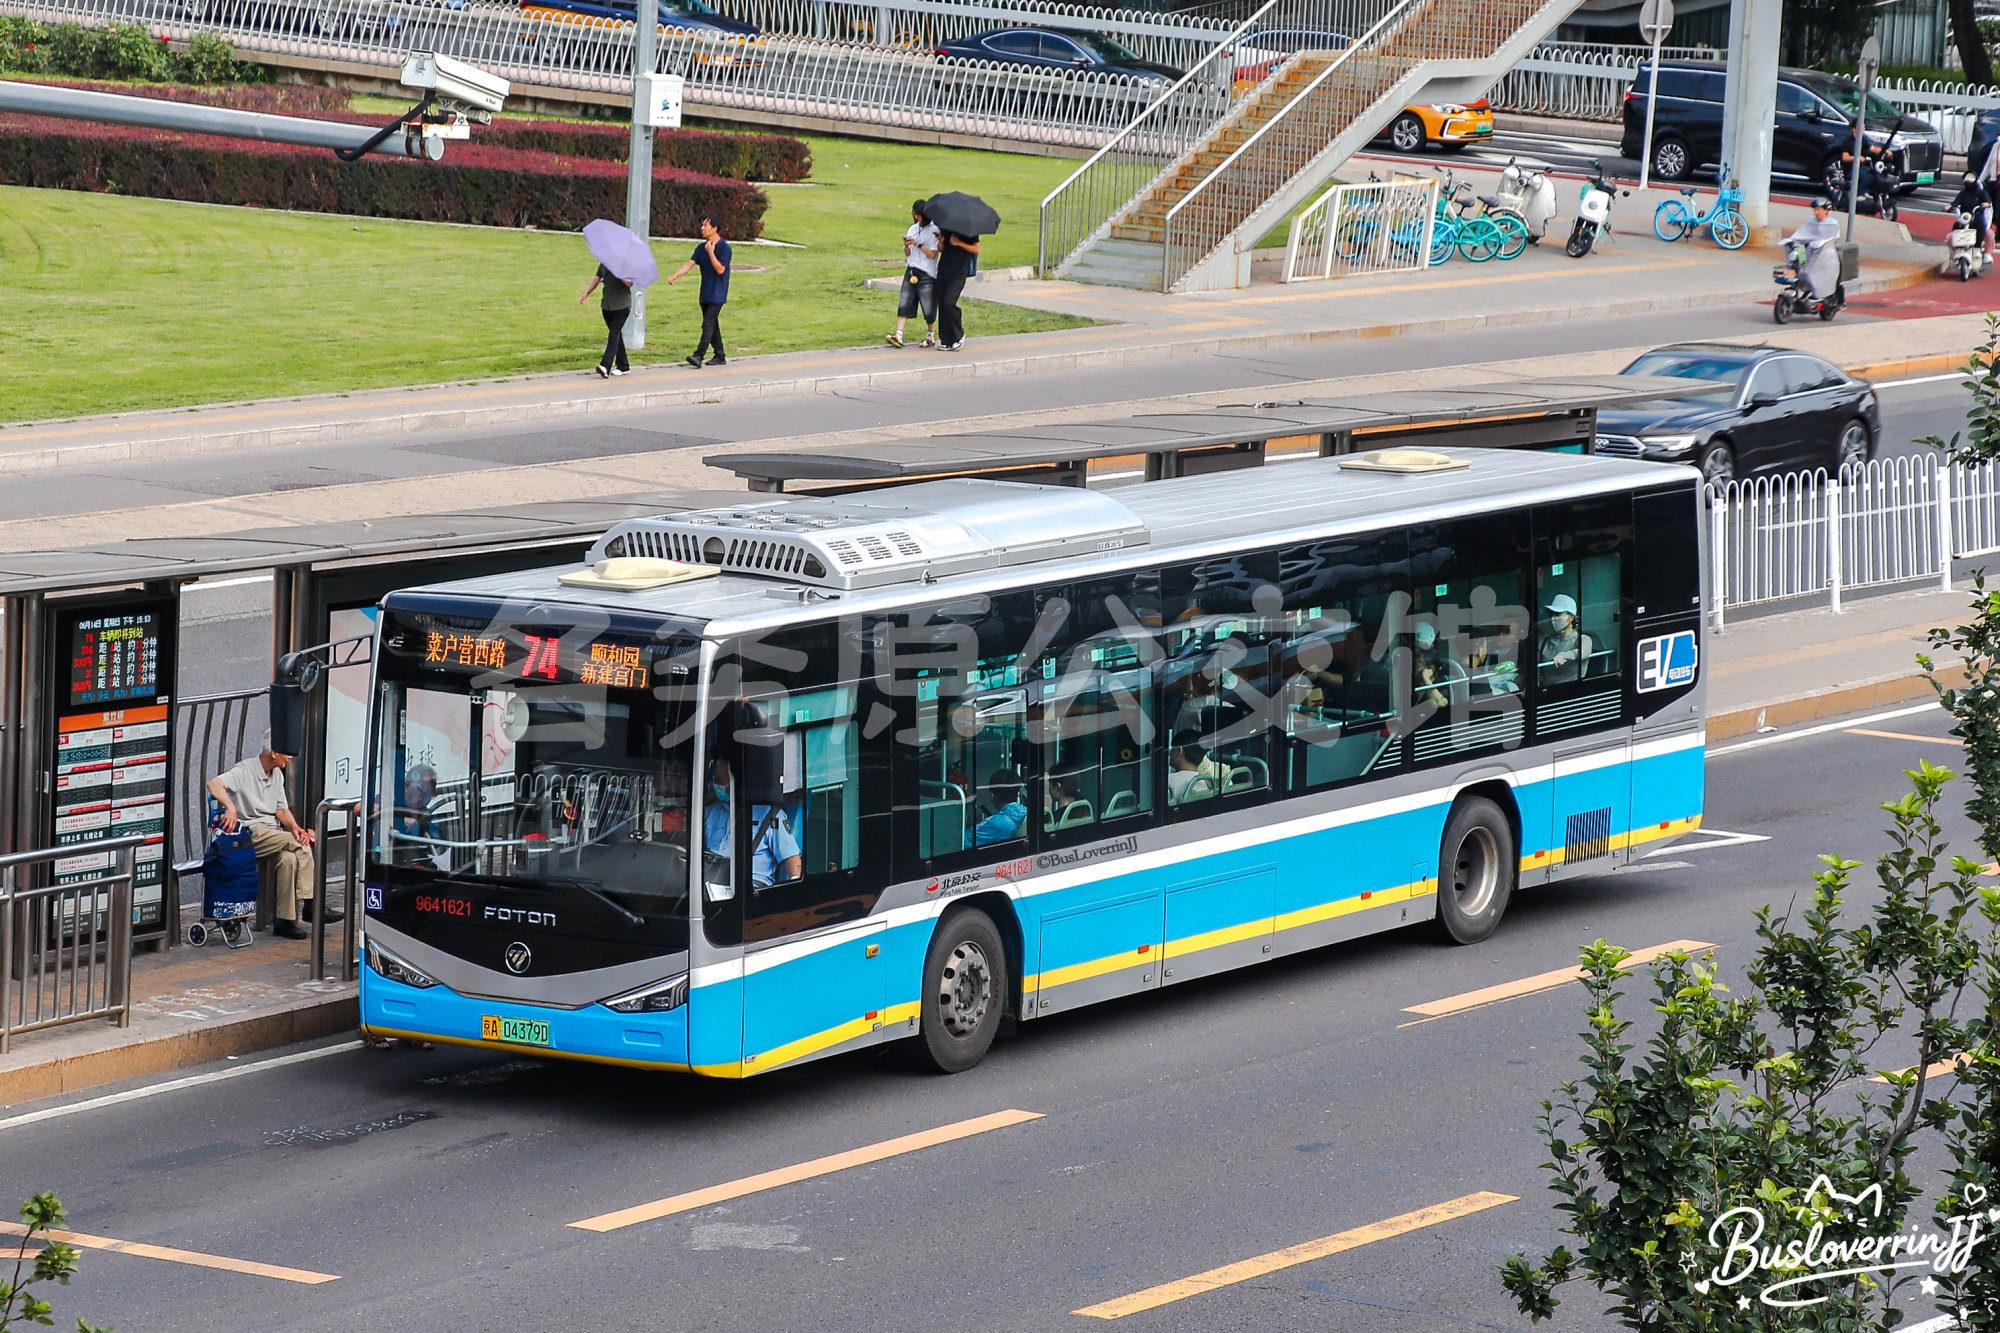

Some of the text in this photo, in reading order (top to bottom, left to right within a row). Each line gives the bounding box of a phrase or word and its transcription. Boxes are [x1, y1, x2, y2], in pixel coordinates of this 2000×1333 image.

[99, 627, 144, 642] 车辆即将到站
[425, 631, 506, 669] 菜户营西路
[521, 634, 559, 680] 74
[590, 642, 641, 668] 颐和园
[580, 661, 648, 689] 新建宫门
[994, 858, 1034, 880] 9641621
[941, 872, 982, 890] 北京公交
[416, 895, 472, 917] 9641621
[483, 905, 557, 927] FOTON
